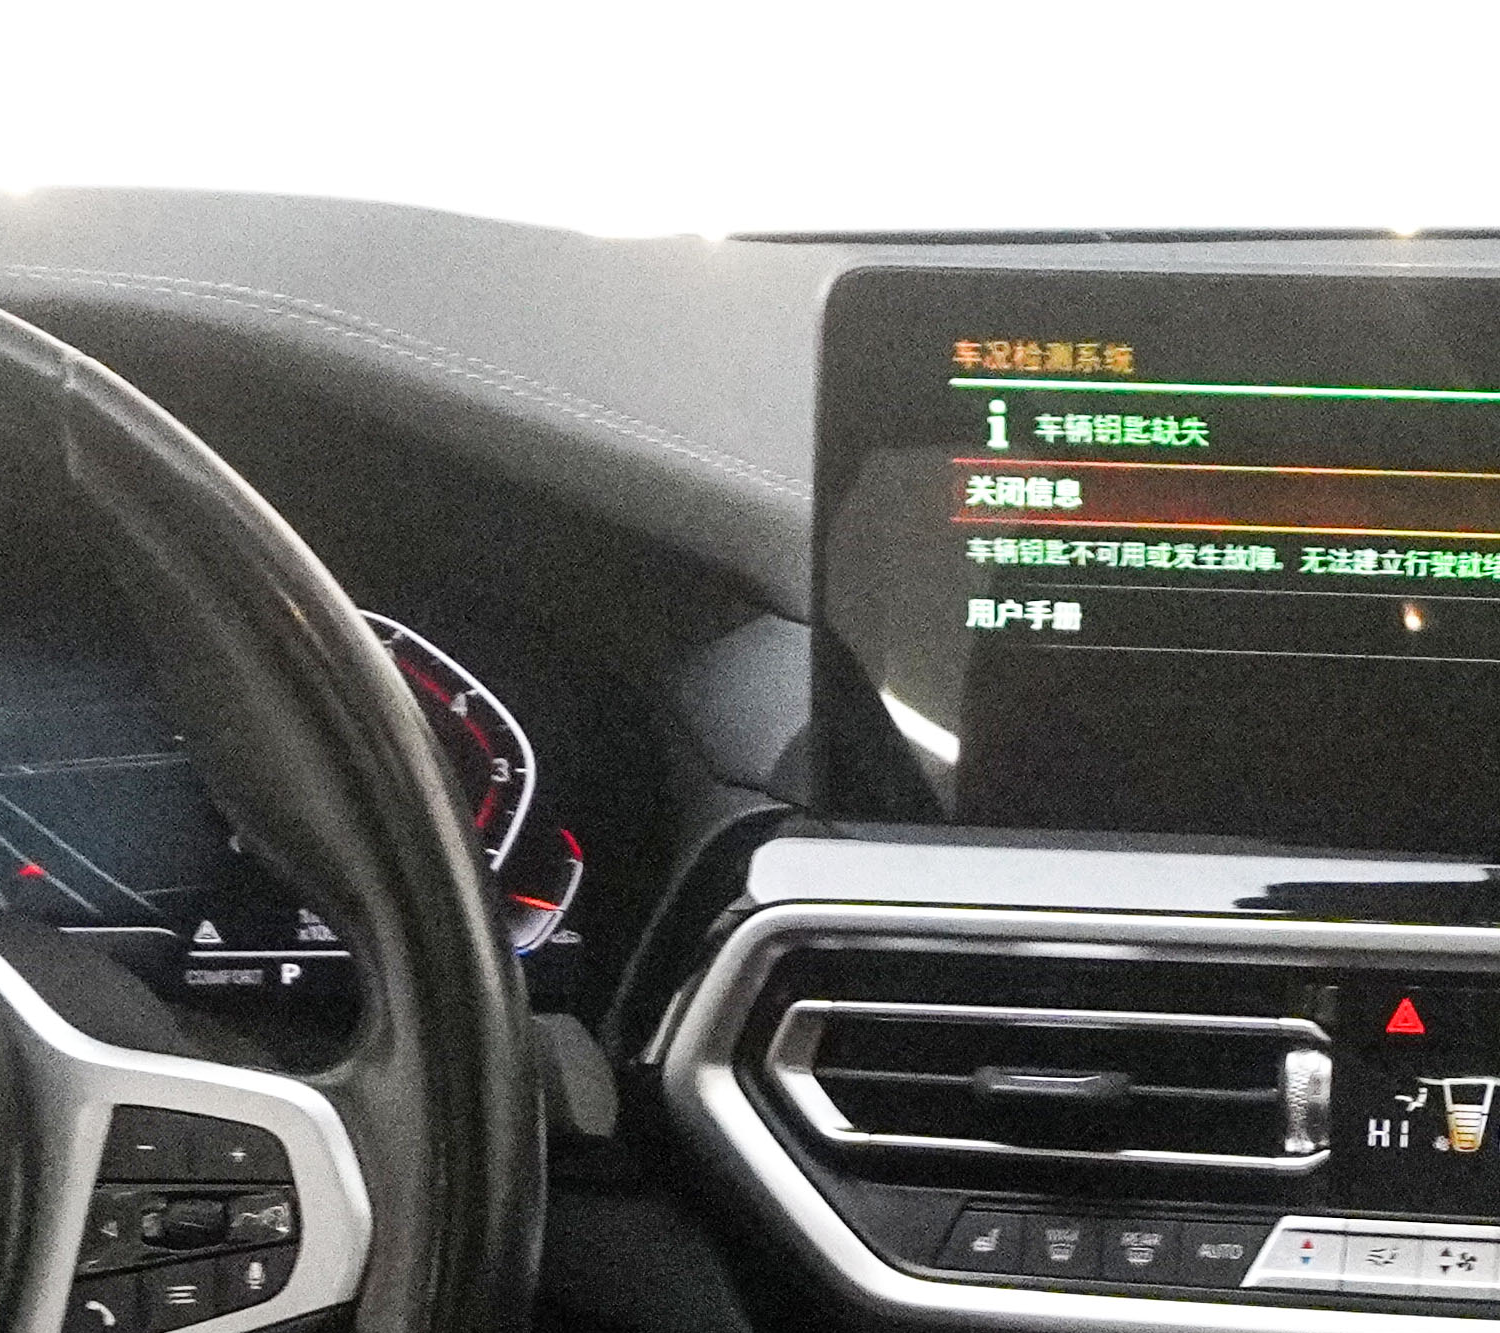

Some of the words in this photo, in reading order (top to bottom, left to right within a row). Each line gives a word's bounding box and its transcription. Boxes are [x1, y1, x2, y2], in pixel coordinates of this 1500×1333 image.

[952, 341, 1133, 374] 车况检测系统
[1034, 413, 1210, 447] 车辆钥匙缺失
[965, 475, 1083, 509] 关闭信息
[965, 598, 1083, 631] 用户手册
[451, 693, 468, 718] 4
[491, 757, 510, 782] 3
[280, 963, 301, 984] P
[1367, 1117, 1409, 1148] HI
[1197, 1243, 1244, 1260] AUTO
